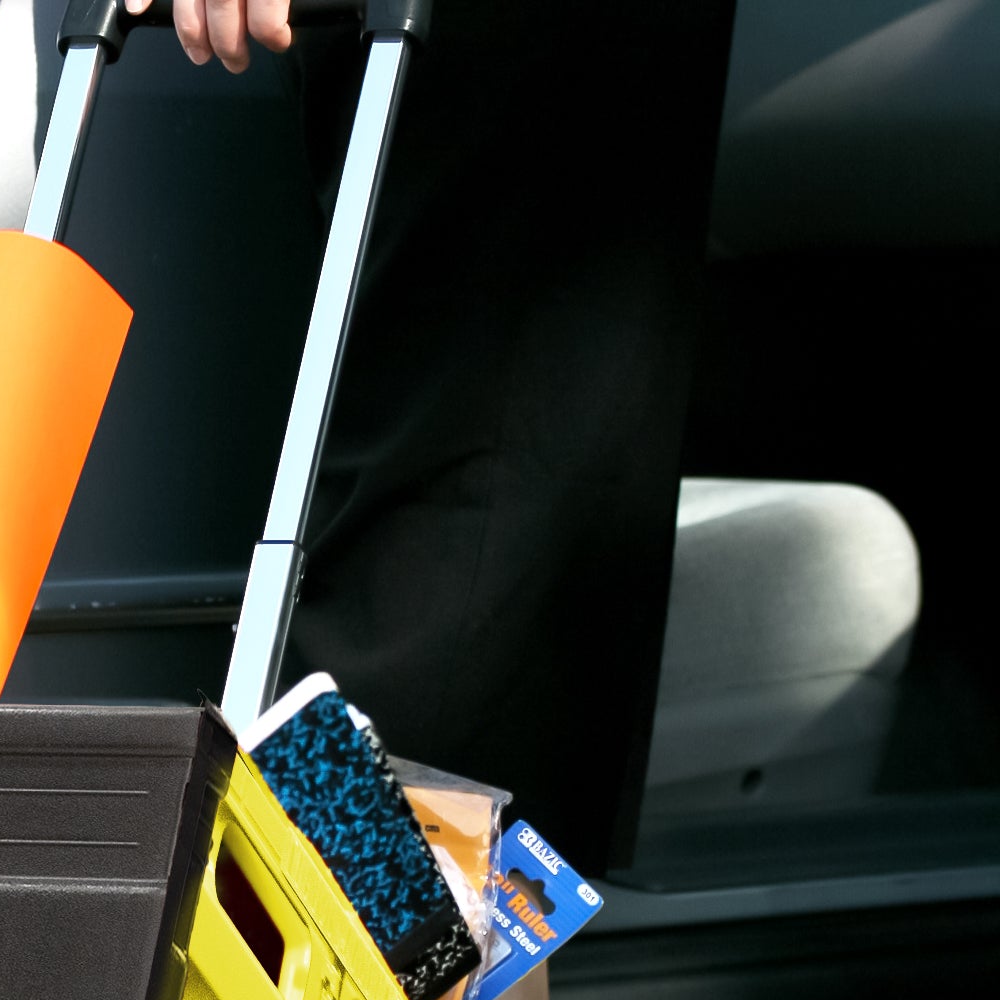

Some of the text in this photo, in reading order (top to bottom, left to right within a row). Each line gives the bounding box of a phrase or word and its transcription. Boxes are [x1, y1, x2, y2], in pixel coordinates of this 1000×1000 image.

[530, 839, 564, 873] BAZIC
[506, 891, 558, 943] Ruler
[509, 924, 542, 956] Steel
